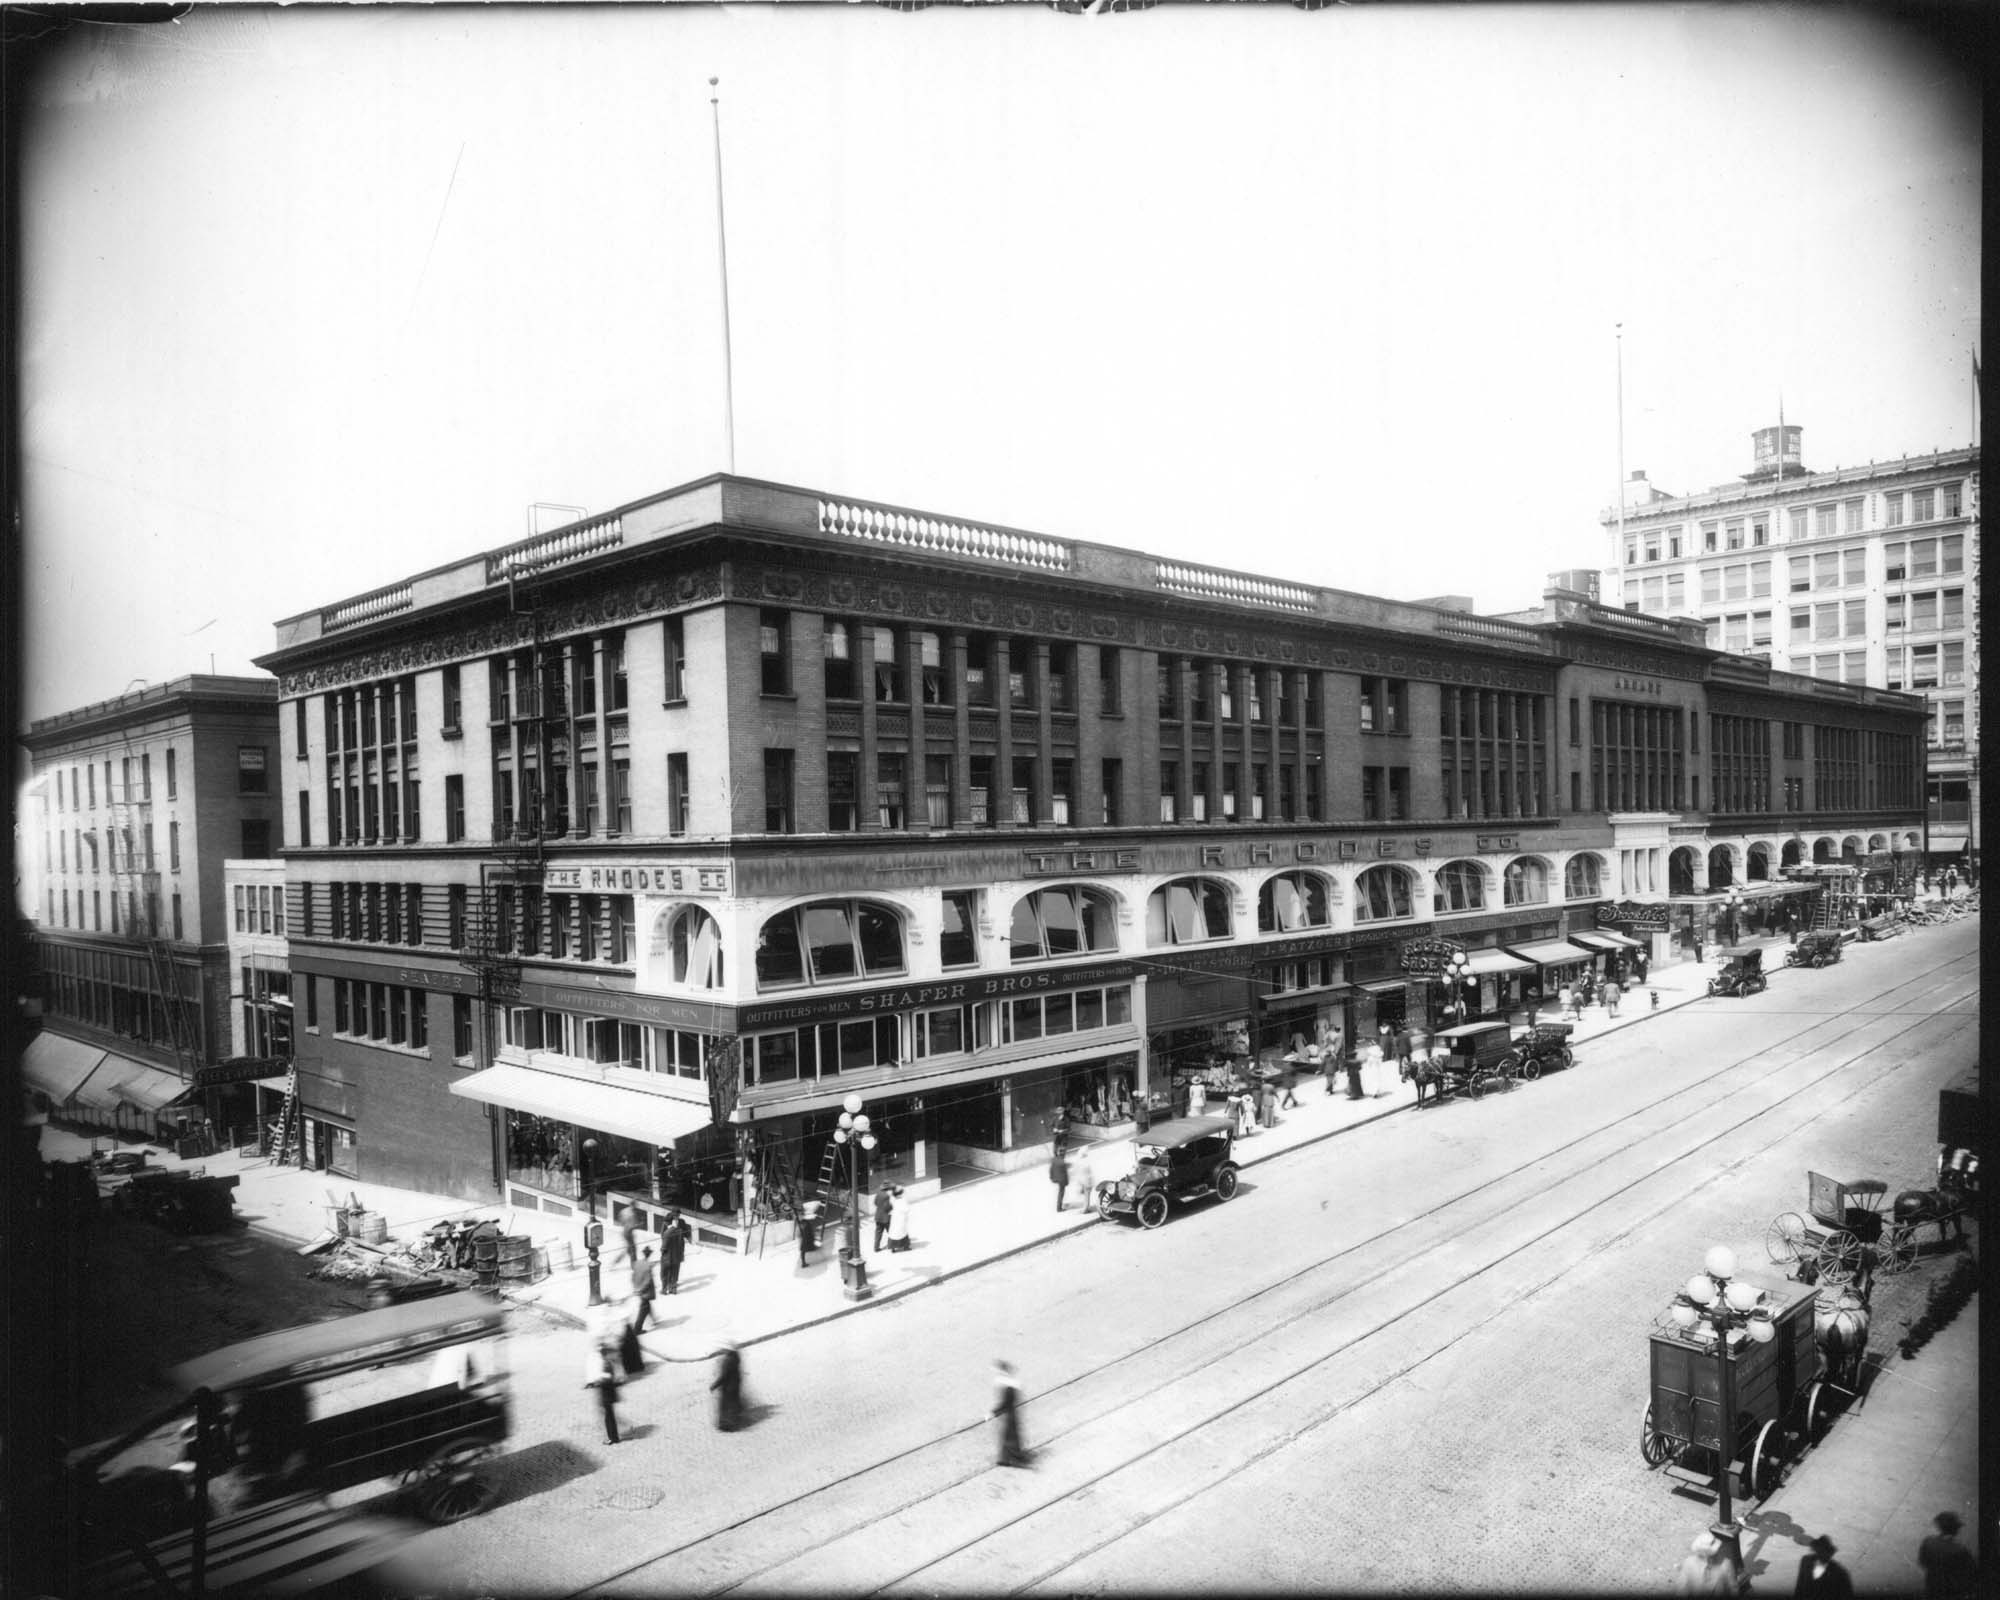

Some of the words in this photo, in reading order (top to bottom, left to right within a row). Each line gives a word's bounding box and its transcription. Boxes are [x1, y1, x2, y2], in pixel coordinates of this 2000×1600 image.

[1030, 851, 1138, 871] THE
[1202, 837, 1432, 866] RHODES
[549, 873, 580, 885] THE
[592, 868, 683, 891] RHODES
[700, 873, 726, 888] CO
[1400, 955, 1438, 969] SHOE
[400, 969, 462, 988] SHAFER
[556, 992, 625, 1010] OUTFITTERS
[636, 1003, 661, 1016] FOR
[671, 1007, 699, 1020] MEN
[747, 1006, 811, 1024] OUTFITTERS
[829, 1001, 850, 1013] MEN
[860, 984, 967, 1010] SHAFER
[985, 973, 1057, 994] BROS.
